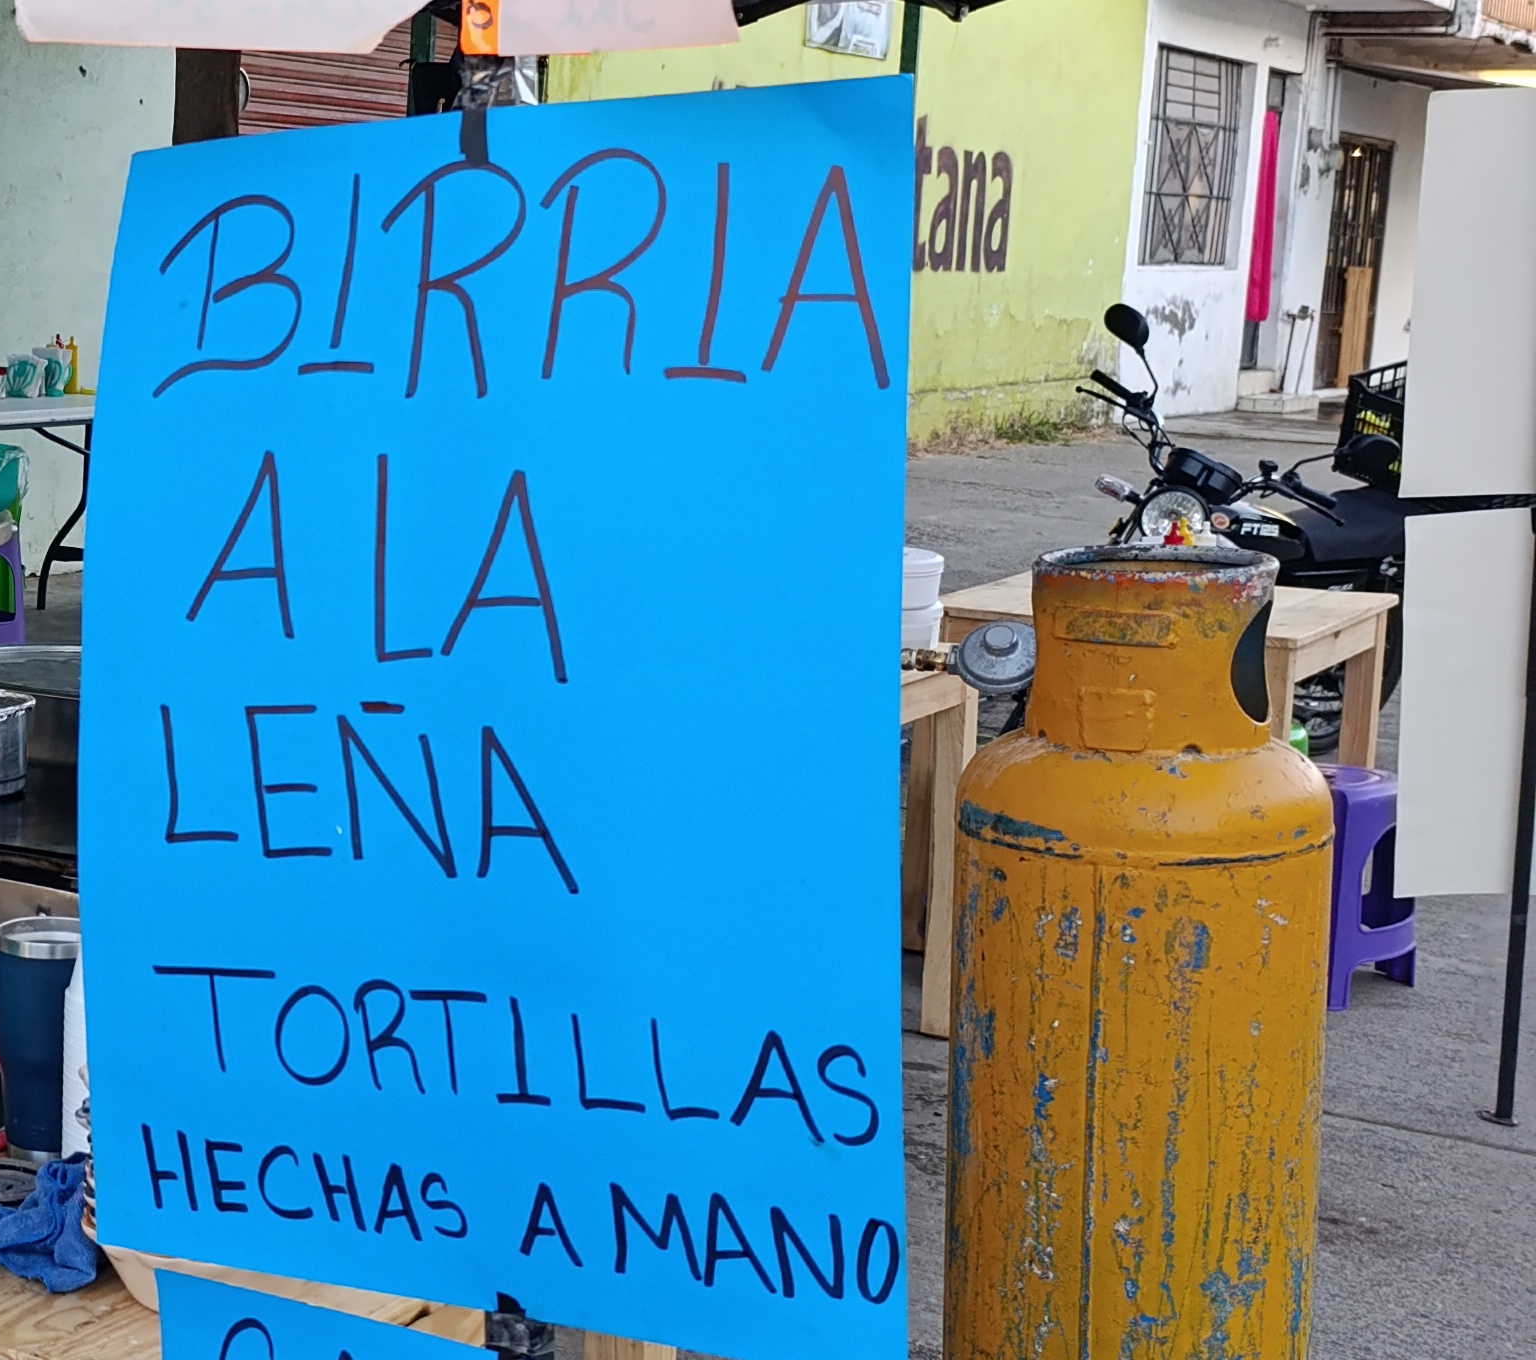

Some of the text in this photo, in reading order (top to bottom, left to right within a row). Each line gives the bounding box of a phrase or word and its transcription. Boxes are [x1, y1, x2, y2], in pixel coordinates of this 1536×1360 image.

[152, 147, 890, 400] BIRRIA
[186, 450, 570, 685] A LA
[159, 701, 579, 895] LEÑA
[152, 964, 881, 1148] TORTILLAS
[141, 1122, 901, 1306] HECHAS A MANO
